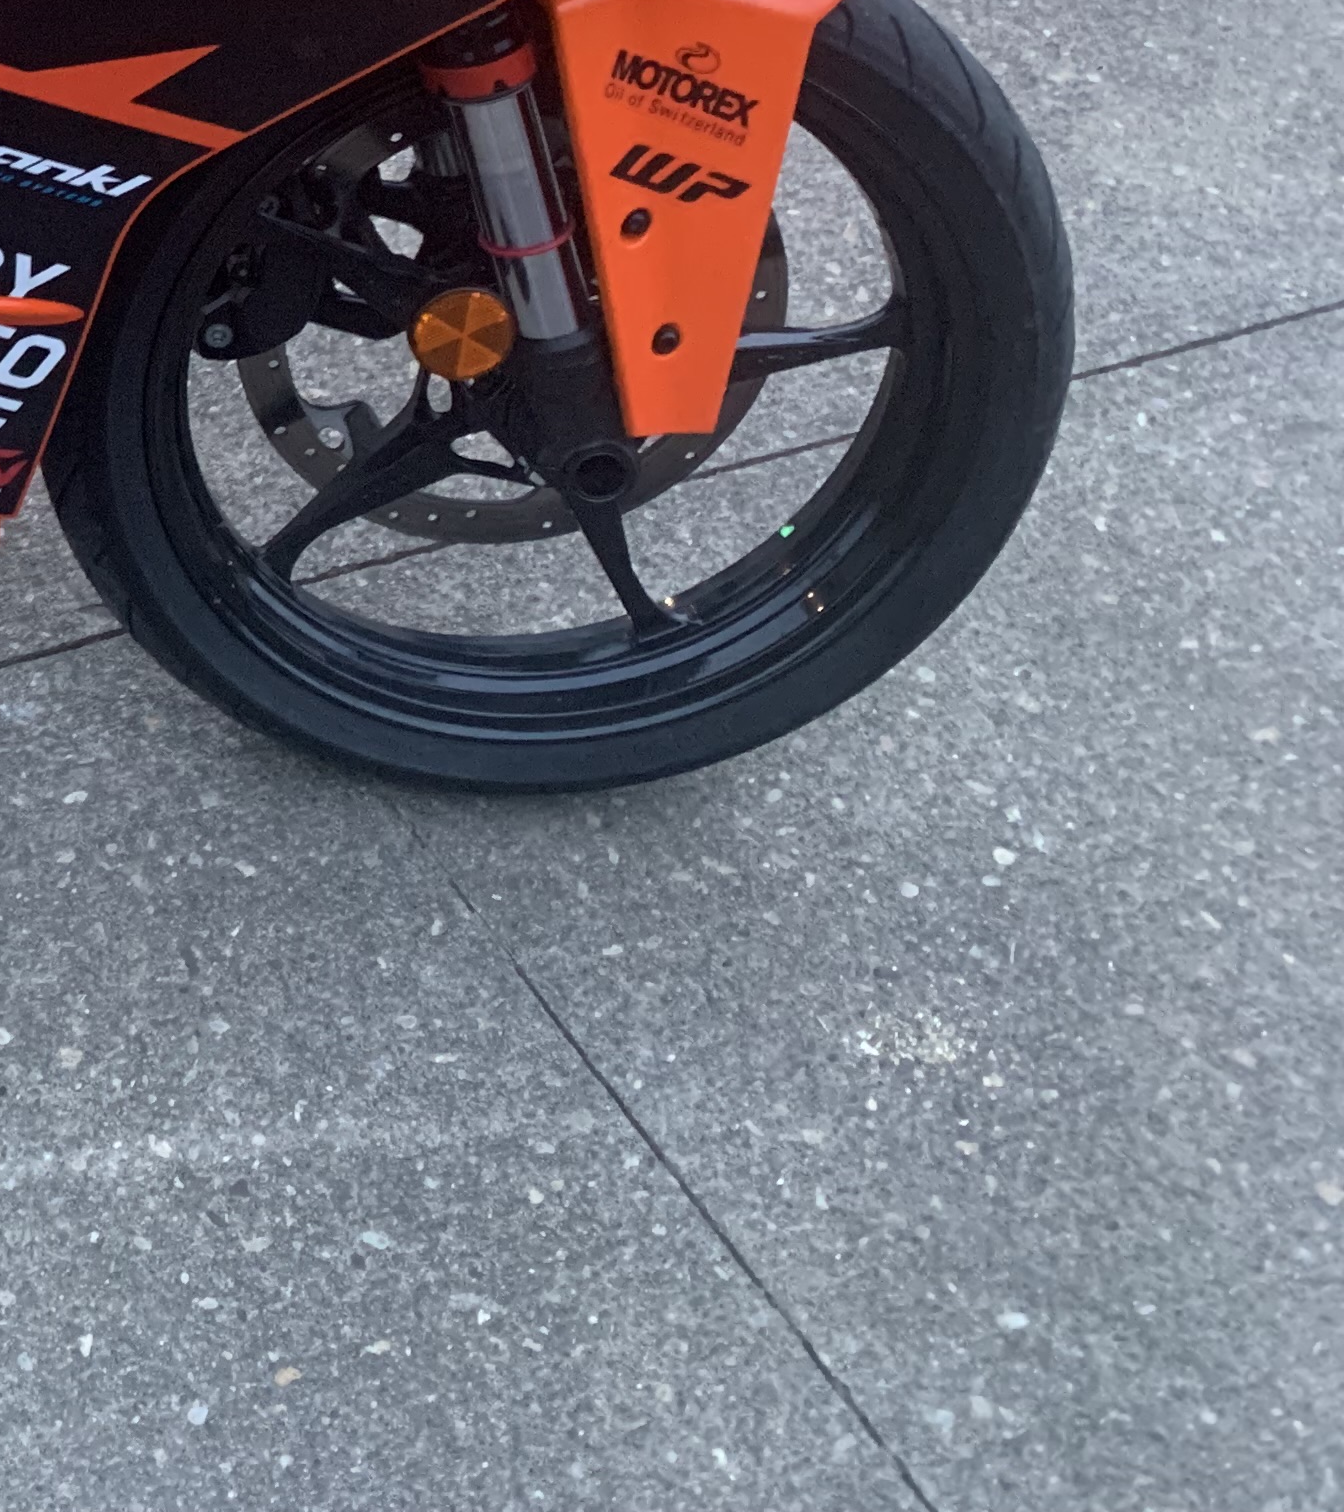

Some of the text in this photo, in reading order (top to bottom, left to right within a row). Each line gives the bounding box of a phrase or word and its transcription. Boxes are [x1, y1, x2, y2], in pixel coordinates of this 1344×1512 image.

[604, 82, 746, 147] Oil of Switzerland
[611, 49, 759, 128] MOTOREX
[610, 144, 752, 203] WP
